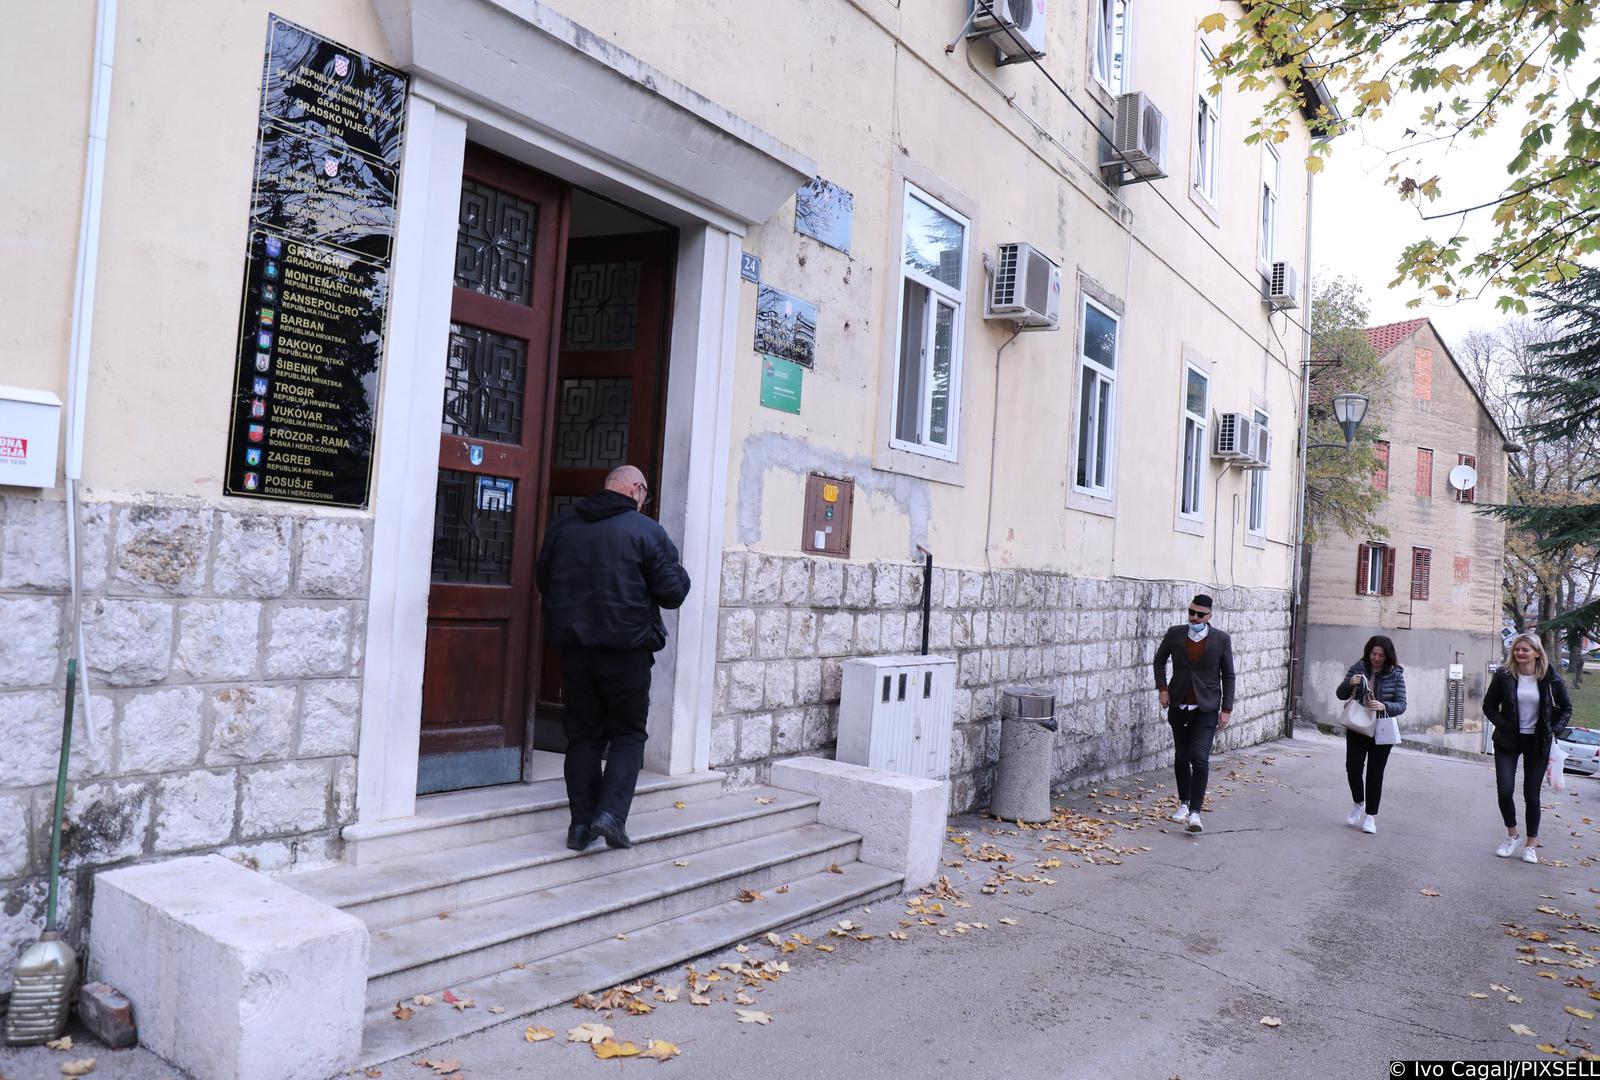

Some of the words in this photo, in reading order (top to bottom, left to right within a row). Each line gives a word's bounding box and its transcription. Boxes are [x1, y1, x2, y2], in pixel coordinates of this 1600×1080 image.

[300, 66, 340, 87] REPUBLIKA
[296, 99, 343, 124] GRADSKO
[317, 97, 340, 112] GRAD
[341, 107, 359, 120] SINJ
[326, 124, 344, 137] SINJ
[287, 244, 322, 262] GRAD
[325, 254, 349, 270] SINJ
[744, 257, 756, 273] 24
[286, 255, 322, 272] GRADOVI
[323, 266, 364, 284] PRIJATELJI
[284, 279, 319, 293] REPUBLIKA
[285, 268, 373, 300] MONTEMARCIANO
[282, 301, 317, 315] REPUBLIKA
[283, 290, 359, 318] SANSEPOLCRO
[281, 313, 325, 332] BARBAN
[280, 325, 315, 337] REPUBLIKA
[315, 333, 347, 345] HRVATSKA
[278, 336, 323, 354] ĐAKOVO
[278, 347, 313, 360] REPUBLIKA
[313, 355, 345, 367] HRVATSKA
[276, 357, 318, 376] ŠIBENIK
[275, 370, 311, 382] REPUBLIKA
[312, 377, 343, 388] HRVATSKA
[275, 382, 315, 398] TROGIR
[273, 393, 309, 405] REPUBLIKA
[310, 399, 341, 410] HRVATSKA
[273, 405, 323, 422] VUKOVAR
[271, 415, 307, 427] REPUBLIKA
[307, 422, 339, 432] HRVATSKA
[269, 439, 291, 449] BOSNA
[295, 443, 339, 455] HERCEGOVINA
[270, 428, 314, 443] PROZOR
[321, 435, 350, 448] RAMA
[268, 451, 311, 466] ZAGREB
[267, 463, 302, 474] REPUBLIKA
[303, 467, 334, 478] HRVATSKA
[265, 475, 314, 490] POSUŠJE
[264, 487, 287, 496] BOSNA
[290, 488, 334, 500] HERCEGOVINA
